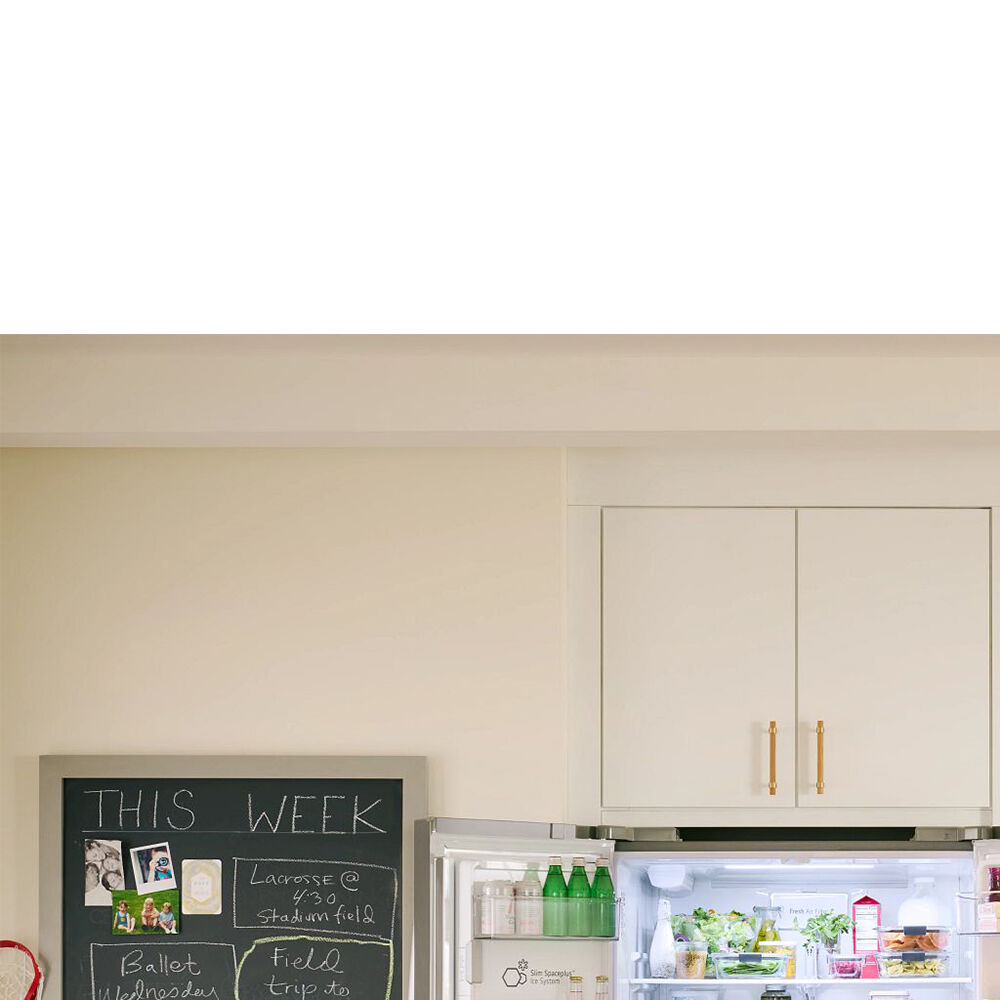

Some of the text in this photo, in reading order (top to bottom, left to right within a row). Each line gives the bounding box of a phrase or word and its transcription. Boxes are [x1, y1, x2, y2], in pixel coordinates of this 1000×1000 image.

[83, 788, 388, 834] THIS WEEK
[293, 888, 336, 905] 4:30
[333, 904, 376, 924] field
[121, 949, 200, 976] Ballet
[270, 946, 344, 973] Field
[324, 980, 350, 996] to
